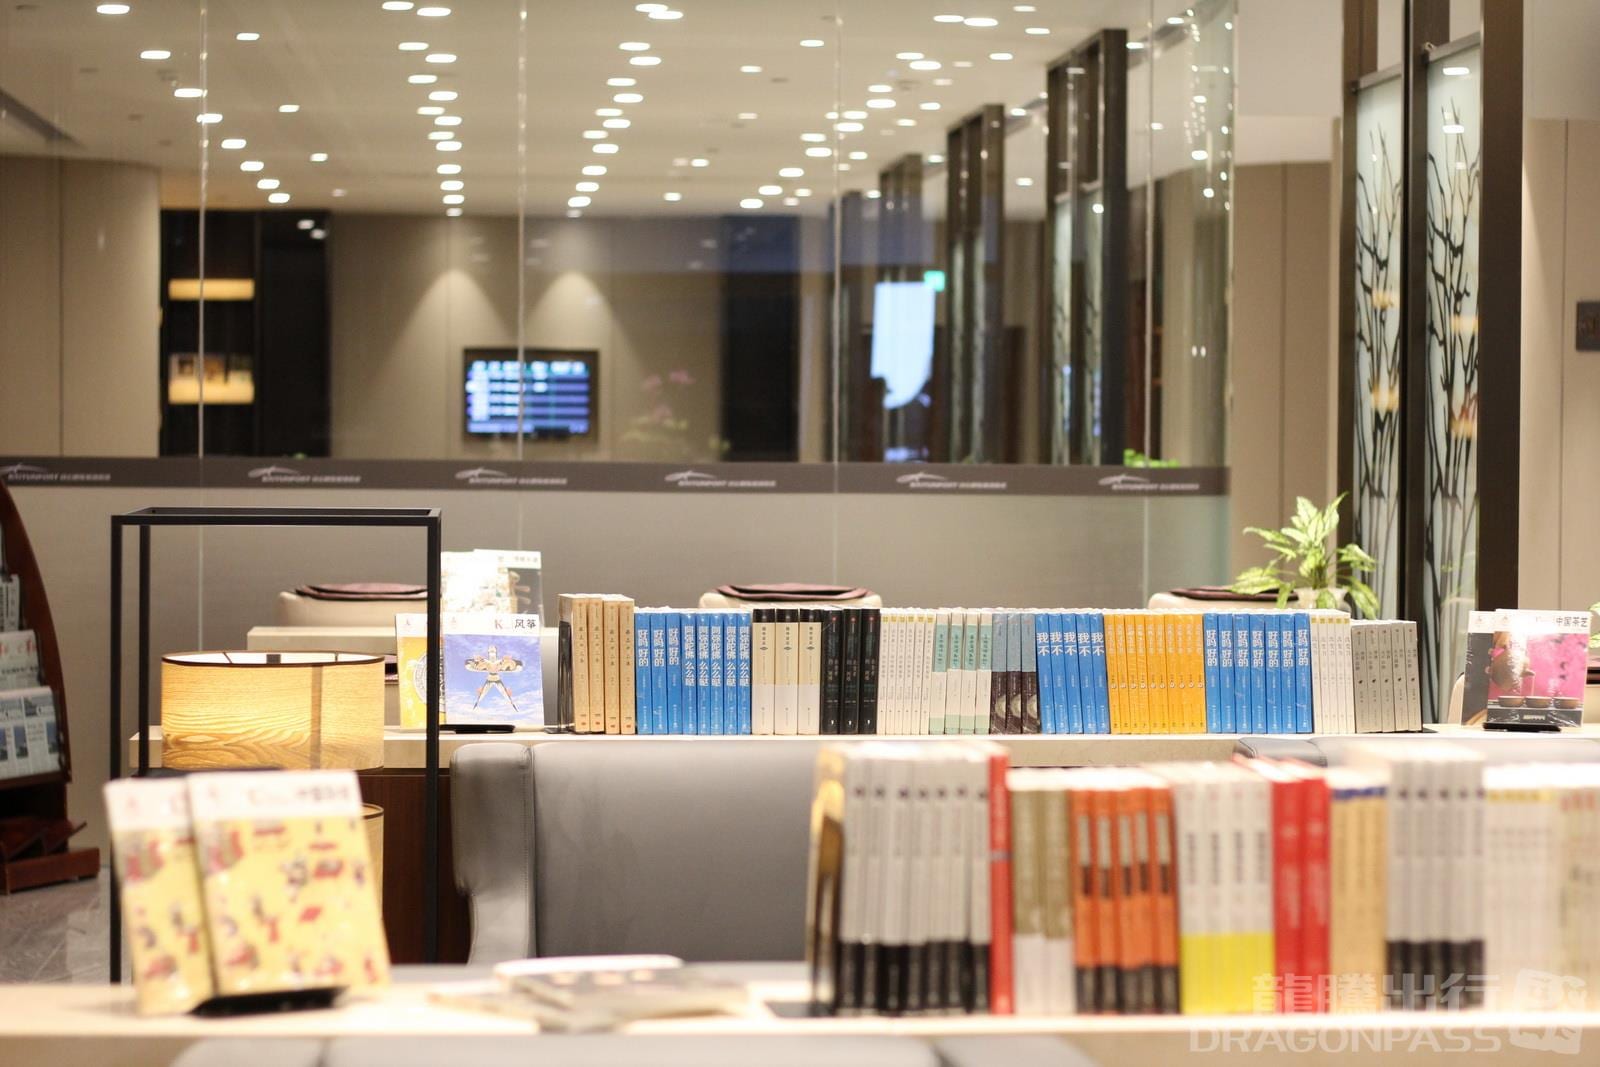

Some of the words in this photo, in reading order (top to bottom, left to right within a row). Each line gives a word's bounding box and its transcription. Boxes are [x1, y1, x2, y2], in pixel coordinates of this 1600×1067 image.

[514, 618, 537, 630] 风筝
[1036, 632, 1050, 656] 我不
[1050, 631, 1063, 656] 我不
[1064, 632, 1077, 656] 我不
[1078, 632, 1091, 656] 我不
[1091, 632, 1104, 656] 我不
